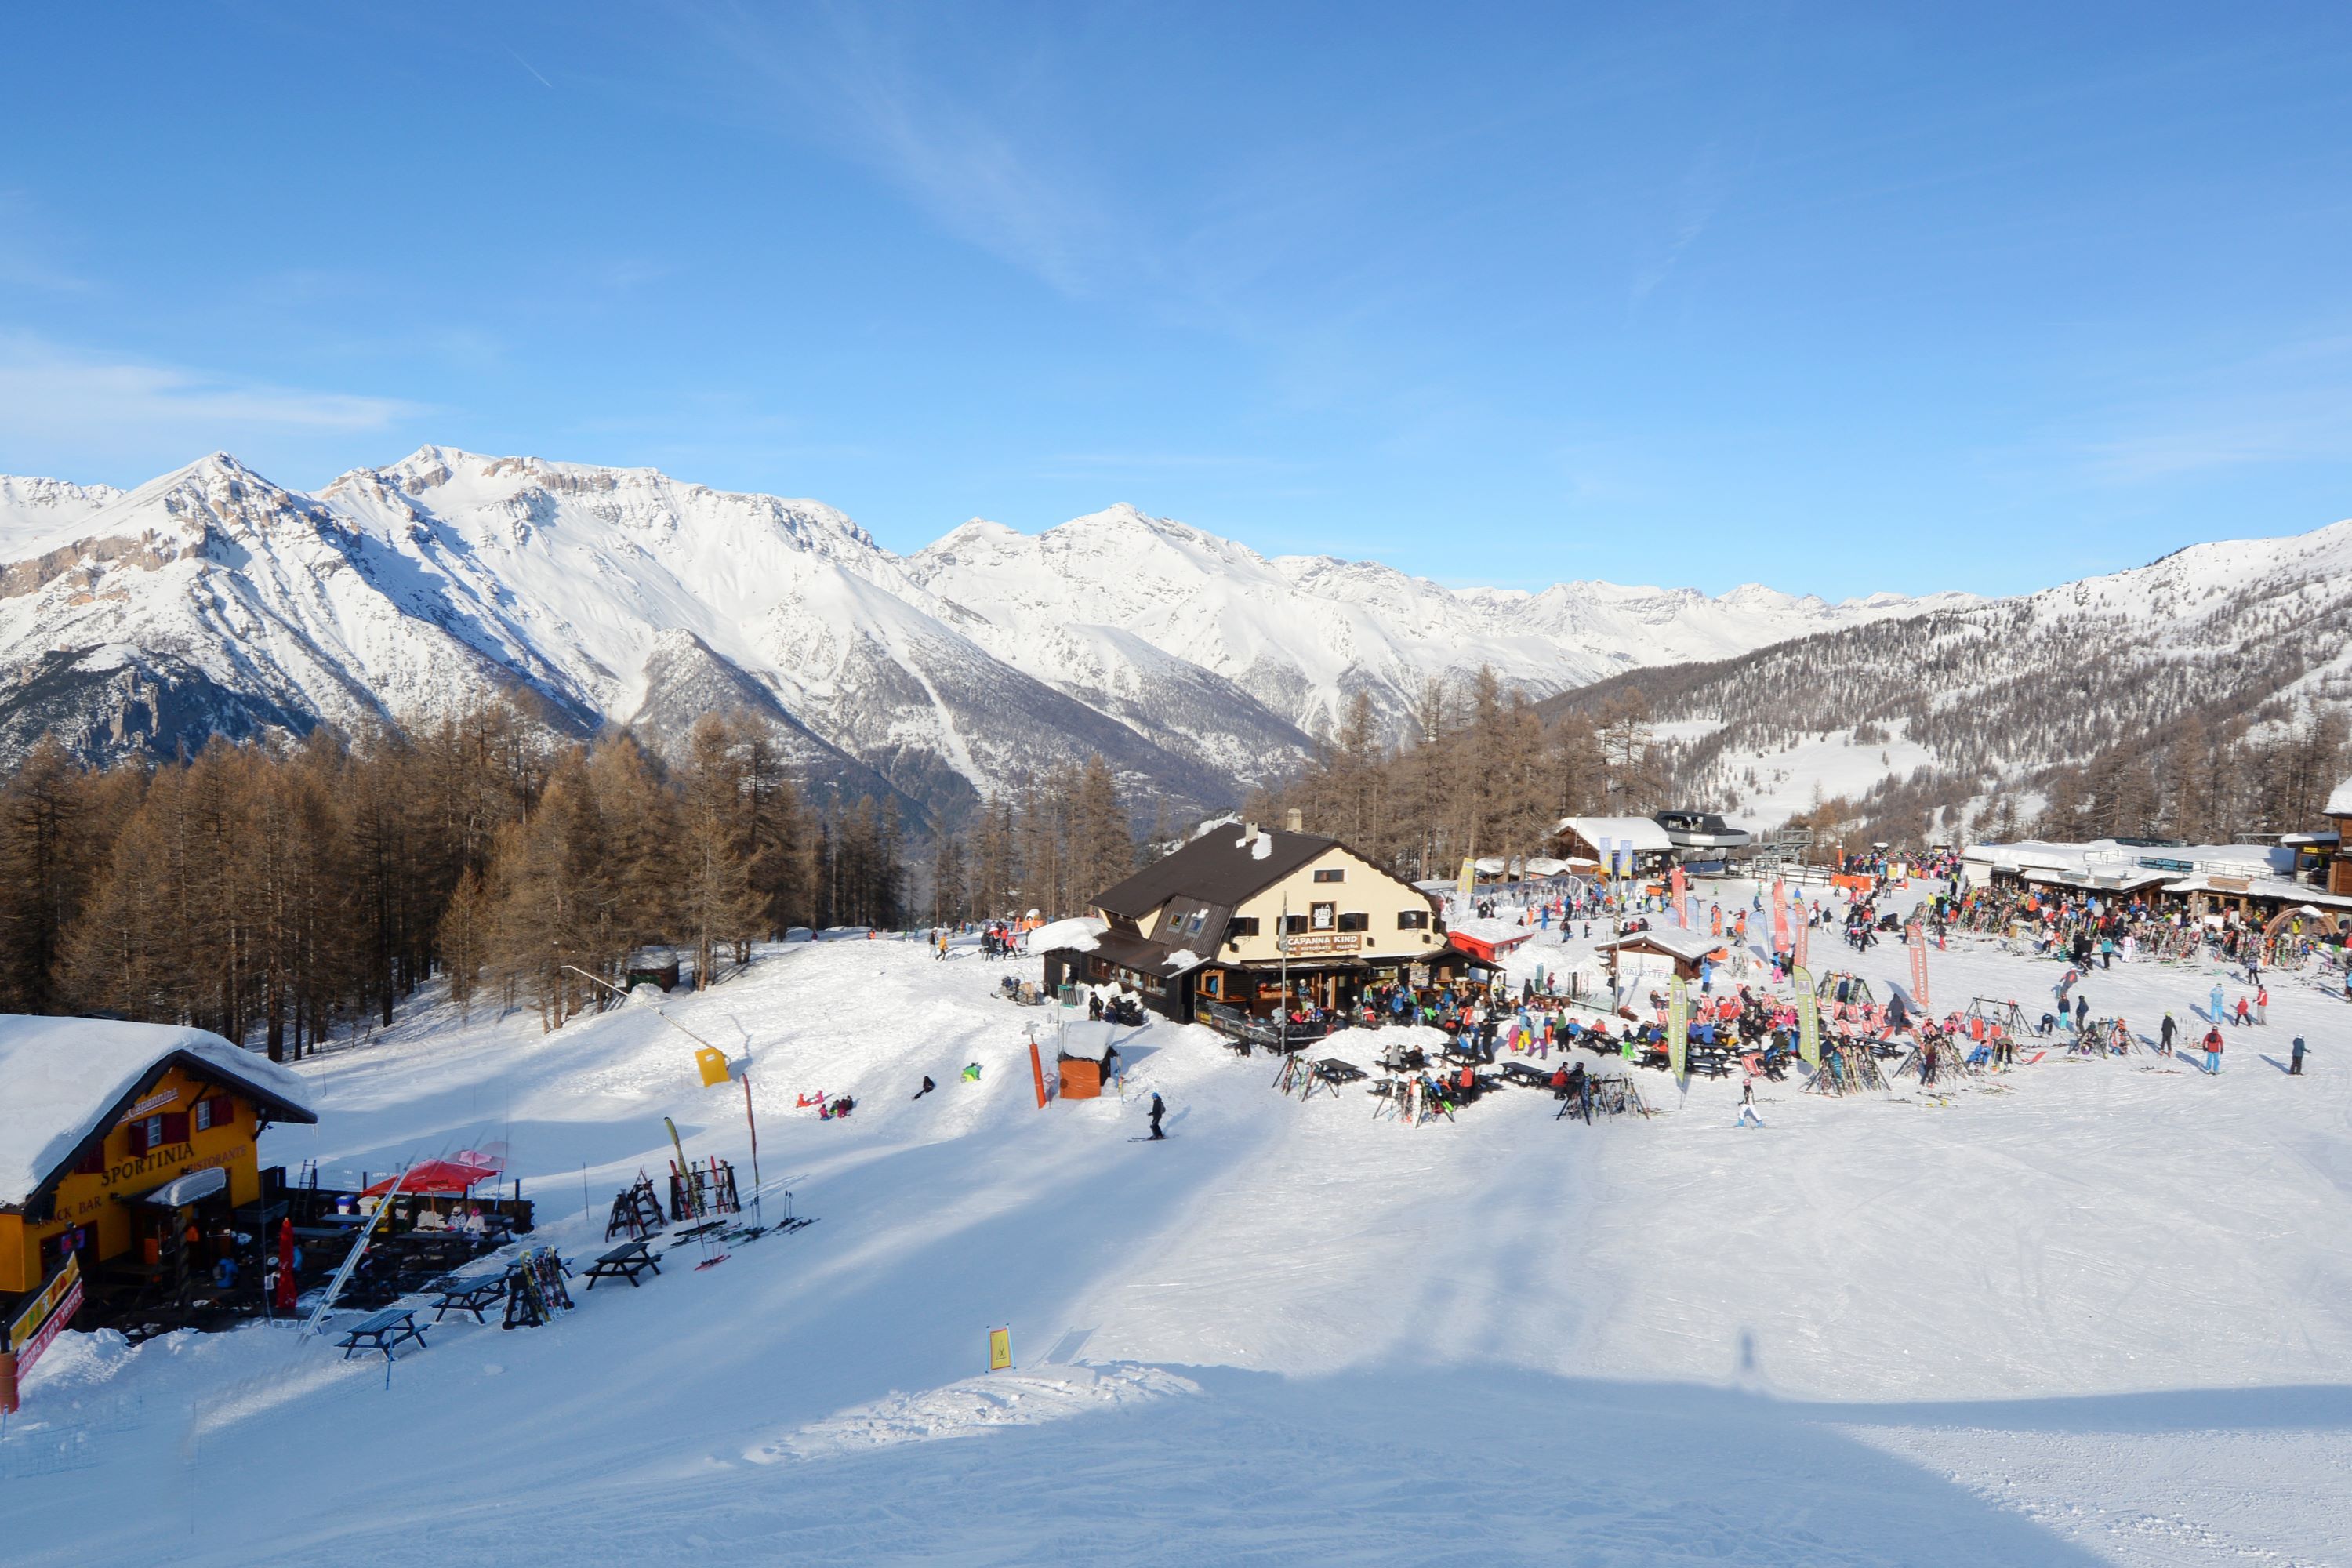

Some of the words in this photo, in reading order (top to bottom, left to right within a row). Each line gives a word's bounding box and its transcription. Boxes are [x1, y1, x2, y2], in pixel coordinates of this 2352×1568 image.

[1287, 937, 1330, 946] CAPANNA
[100, 1142, 194, 1186] SPORTINIA
[79, 1196, 102, 1214] BAR
